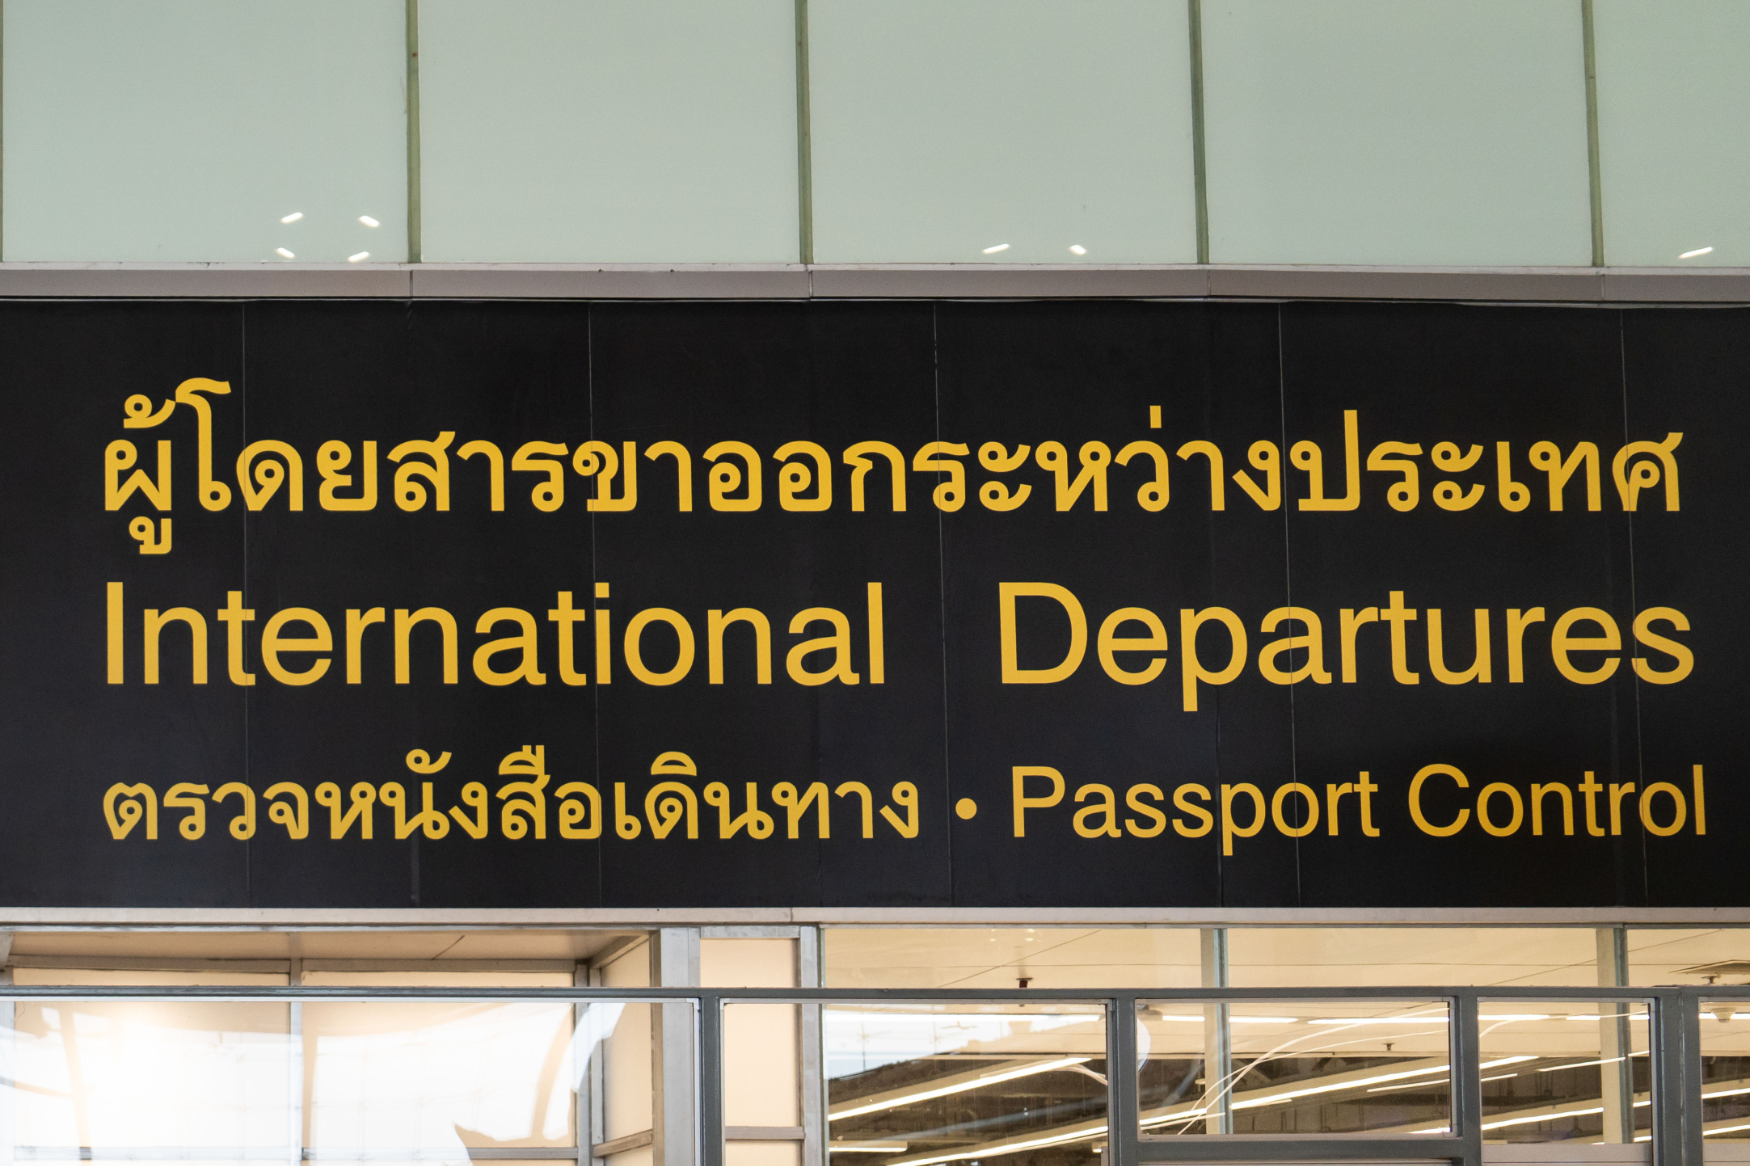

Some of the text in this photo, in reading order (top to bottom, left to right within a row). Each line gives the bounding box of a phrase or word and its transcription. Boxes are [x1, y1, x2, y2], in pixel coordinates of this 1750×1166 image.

[103, 377, 1684, 555] ผู้โดยสารขาออกระหว่างประเทศ
[105, 581, 1695, 712] International Departures
[102, 744, 920, 841] ตรวจหนังสือเดินทาง
[1011, 763, 1707, 857] Passport Control
